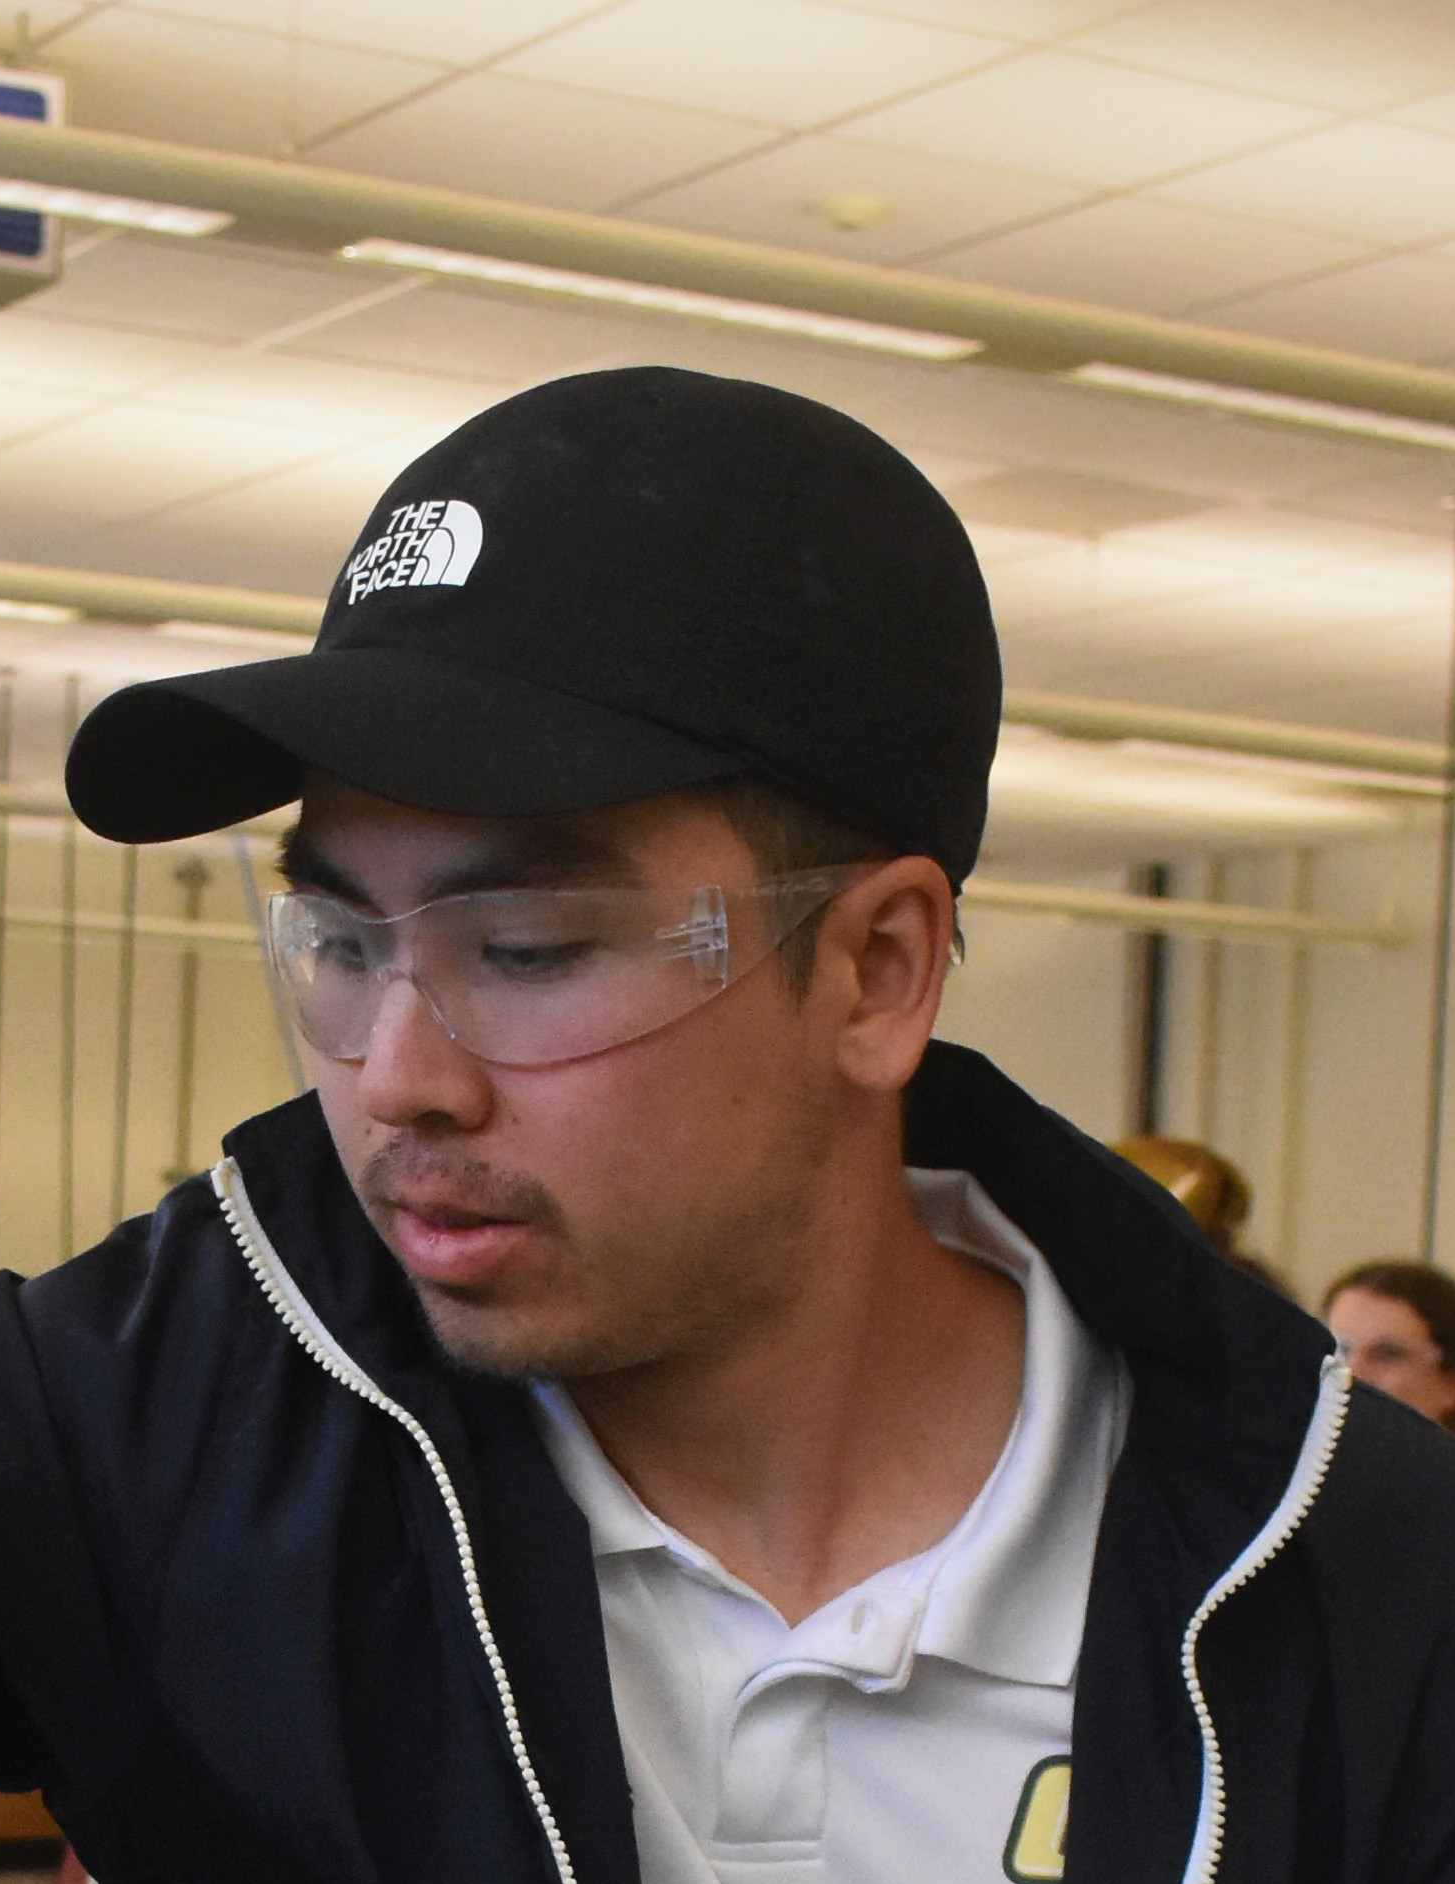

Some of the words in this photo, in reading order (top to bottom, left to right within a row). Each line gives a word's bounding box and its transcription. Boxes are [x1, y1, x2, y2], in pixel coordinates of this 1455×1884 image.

[386, 500, 445, 534] THE
[343, 530, 431, 583] NORTH
[348, 558, 417, 606] FACE
